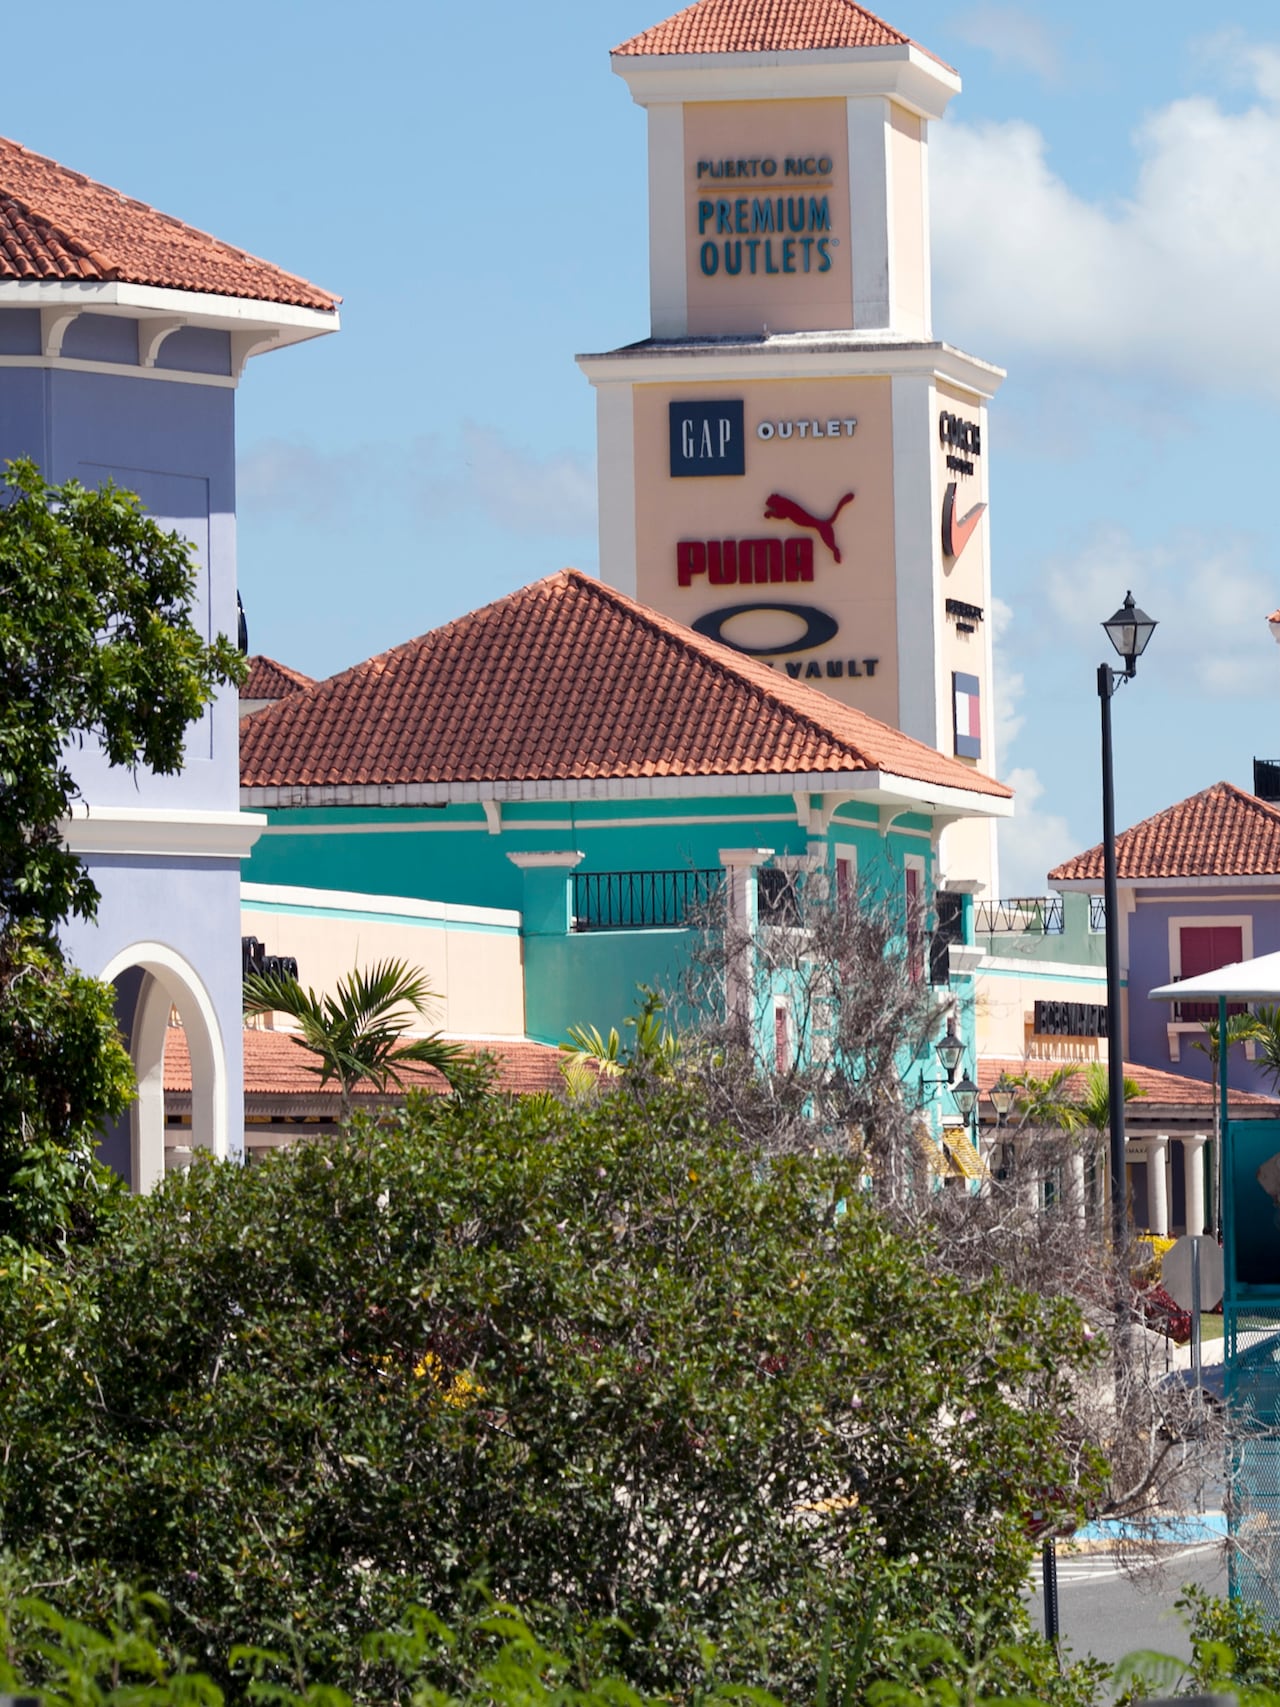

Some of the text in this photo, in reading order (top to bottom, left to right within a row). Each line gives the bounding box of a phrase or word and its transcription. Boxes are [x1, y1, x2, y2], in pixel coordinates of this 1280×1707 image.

[696, 156, 833, 179] PUERTO RICO
[698, 195, 832, 235] PREMIUM
[700, 237, 833, 277] OUTLETS
[681, 418, 858, 459] GAP OUTLET
[677, 538, 814, 587] PUMA
[785, 658, 879, 679] VAULT
